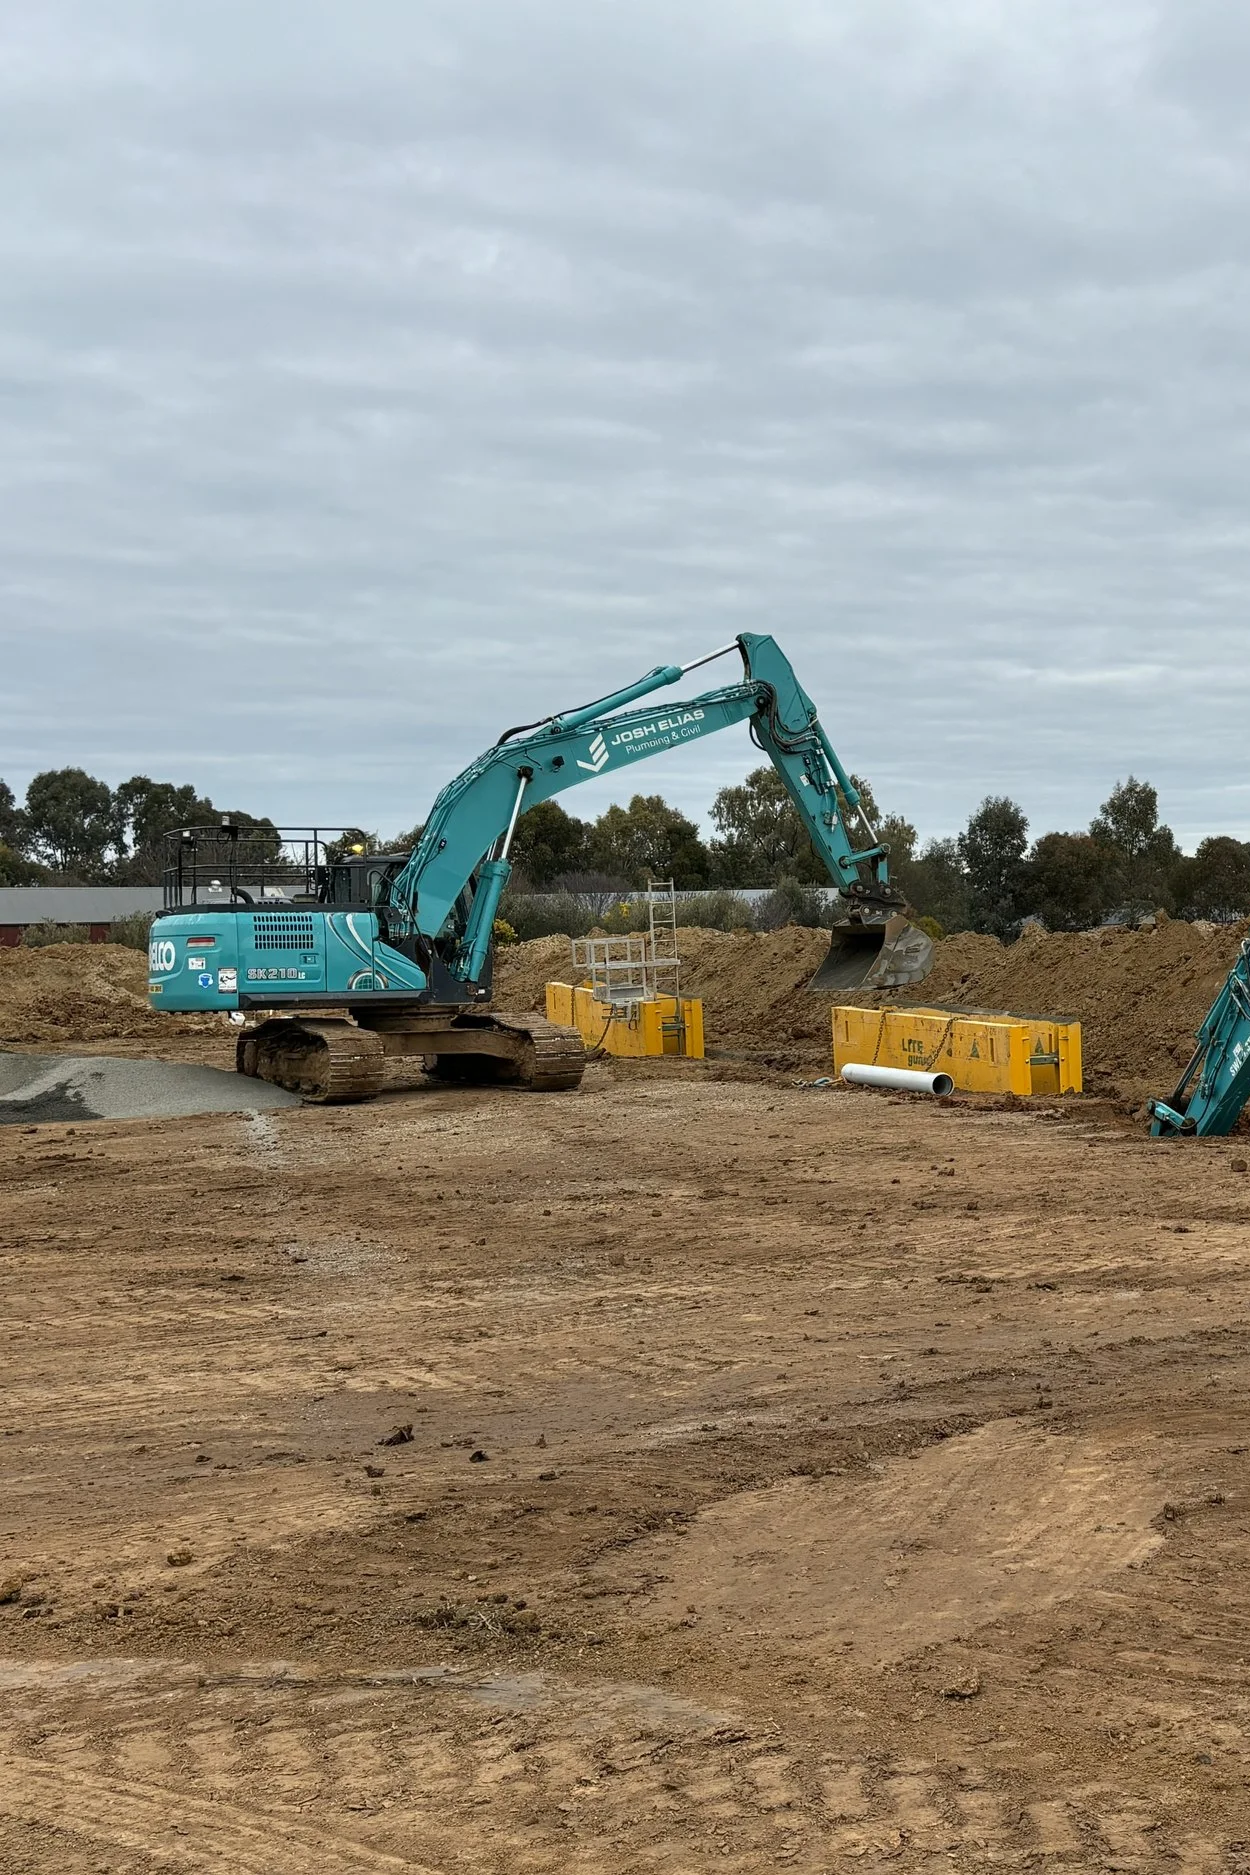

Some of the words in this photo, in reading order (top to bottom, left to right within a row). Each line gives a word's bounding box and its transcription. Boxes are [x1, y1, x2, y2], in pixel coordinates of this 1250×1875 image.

[611, 723, 657, 746] JOSH
[658, 709, 705, 731] ELIAS
[625, 735, 671, 755] Plumbing
[671, 731, 680, 740] &
[681, 724, 701, 739] Civil
[247, 967, 298, 980] SK210
